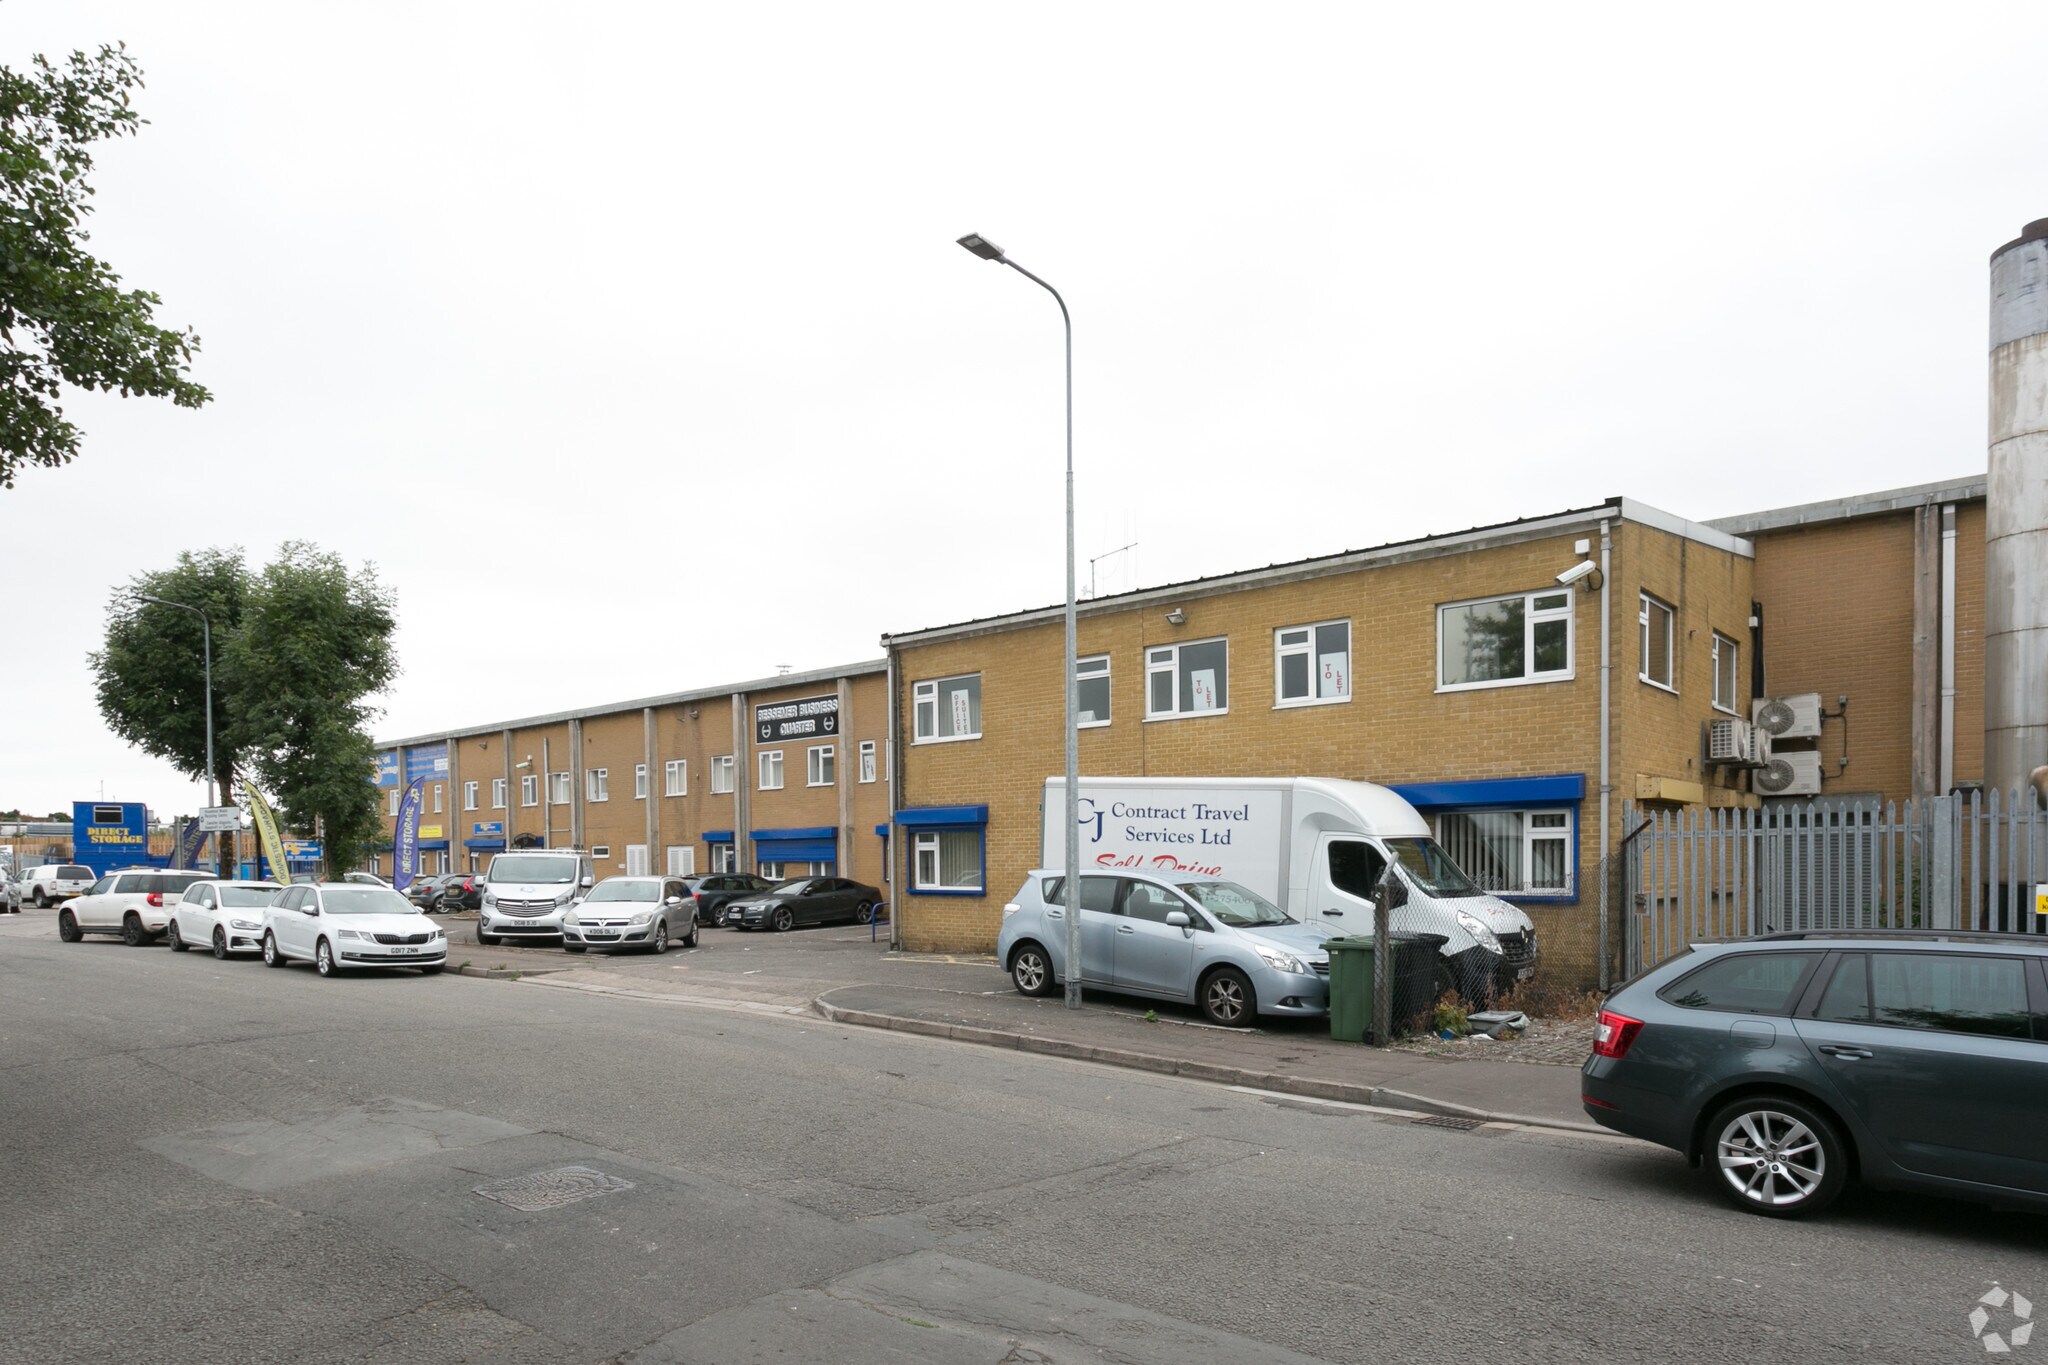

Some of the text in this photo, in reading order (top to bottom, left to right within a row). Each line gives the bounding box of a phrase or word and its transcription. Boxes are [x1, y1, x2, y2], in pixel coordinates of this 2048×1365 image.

[1325, 663, 1332, 680] TO
[1196, 679, 1203, 694] TO
[758, 698, 838, 722] BESSEMER BUSINESS
[780, 719, 815, 736] QUARTER
[1111, 802, 1249, 821] Contract Travel
[87, 827, 143, 844] DIRECT STORAGE
[402, 806, 415, 874] DIRECT STORAGE
[1125, 825, 1232, 845] Services Ltd
[271, 841, 287, 880] DOMESTIC
